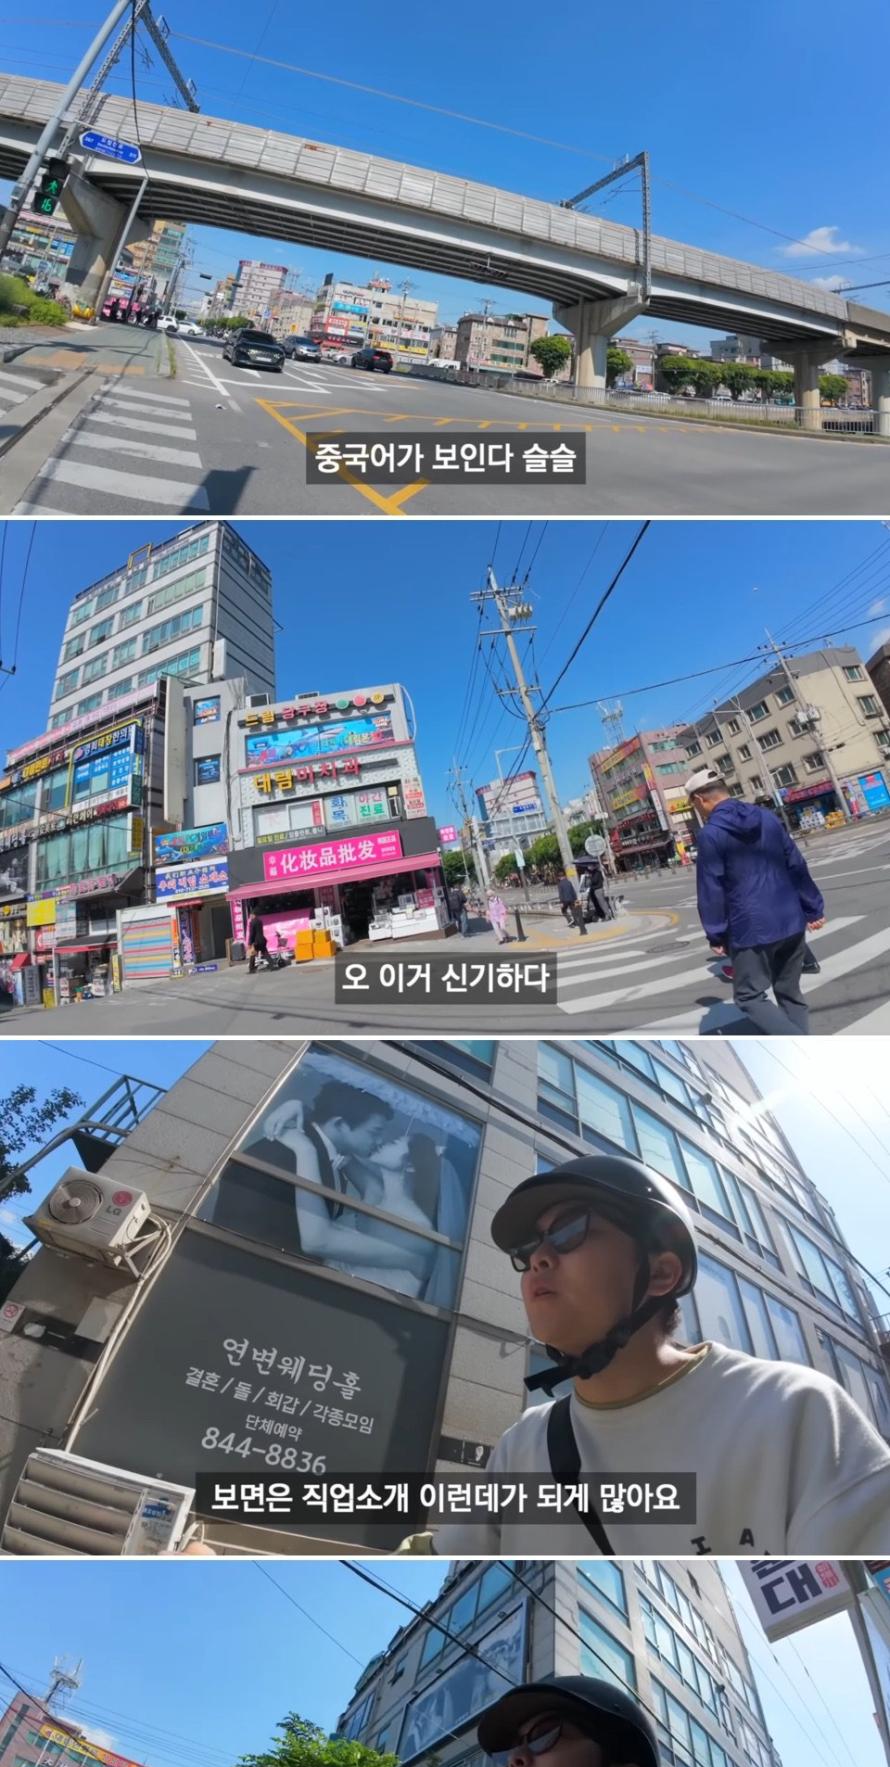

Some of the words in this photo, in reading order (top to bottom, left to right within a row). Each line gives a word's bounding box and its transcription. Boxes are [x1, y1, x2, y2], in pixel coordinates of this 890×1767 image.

[359, 803, 386, 817] 진료
[280, 840, 377, 874] 化妆品批发
[223, 1338, 362, 1400] 연변웨딩홀
[185, 1366, 221, 1392] 결혼
[233, 1381, 252, 1401] 돌
[264, 1391, 300, 1415] 회갑
[313, 1403, 375, 1435] 각종모임
[245, 1414, 303, 1442] 단체예약
[201, 1427, 327, 1475] 844-8836
